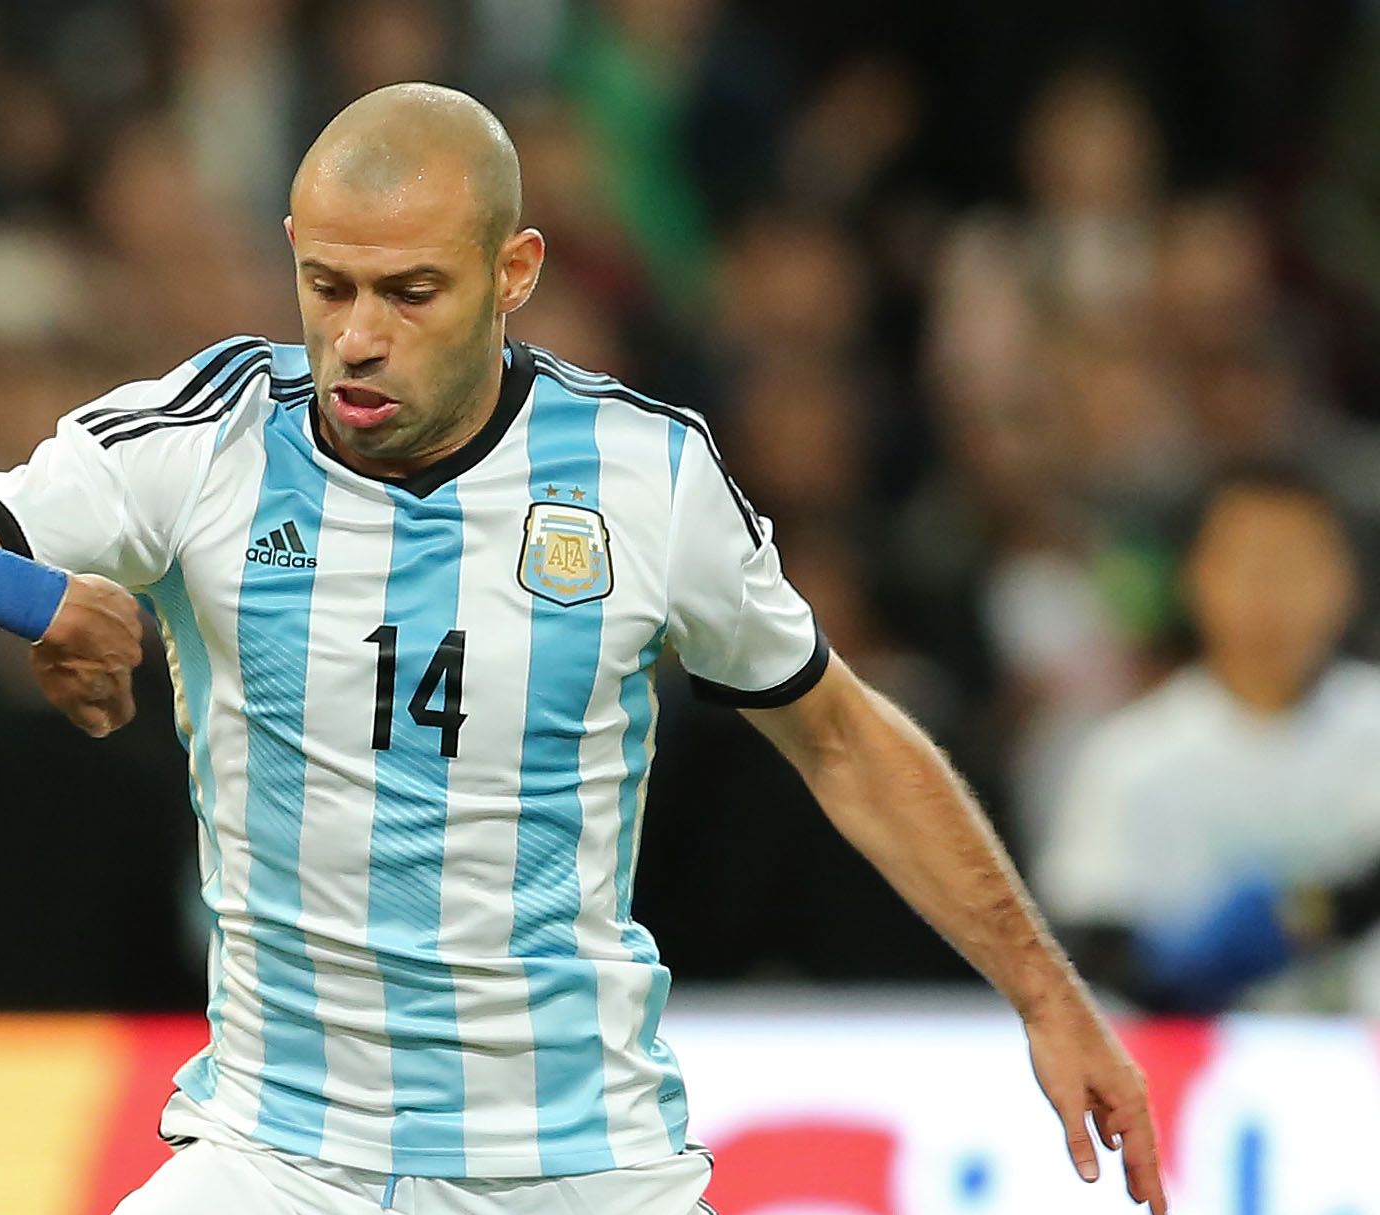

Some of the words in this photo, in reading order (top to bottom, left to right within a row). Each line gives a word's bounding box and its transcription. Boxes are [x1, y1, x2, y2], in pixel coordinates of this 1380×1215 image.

[245, 548, 318, 568] adidas
[548, 534, 587, 574] AFA
[363, 625, 468, 758] 14
